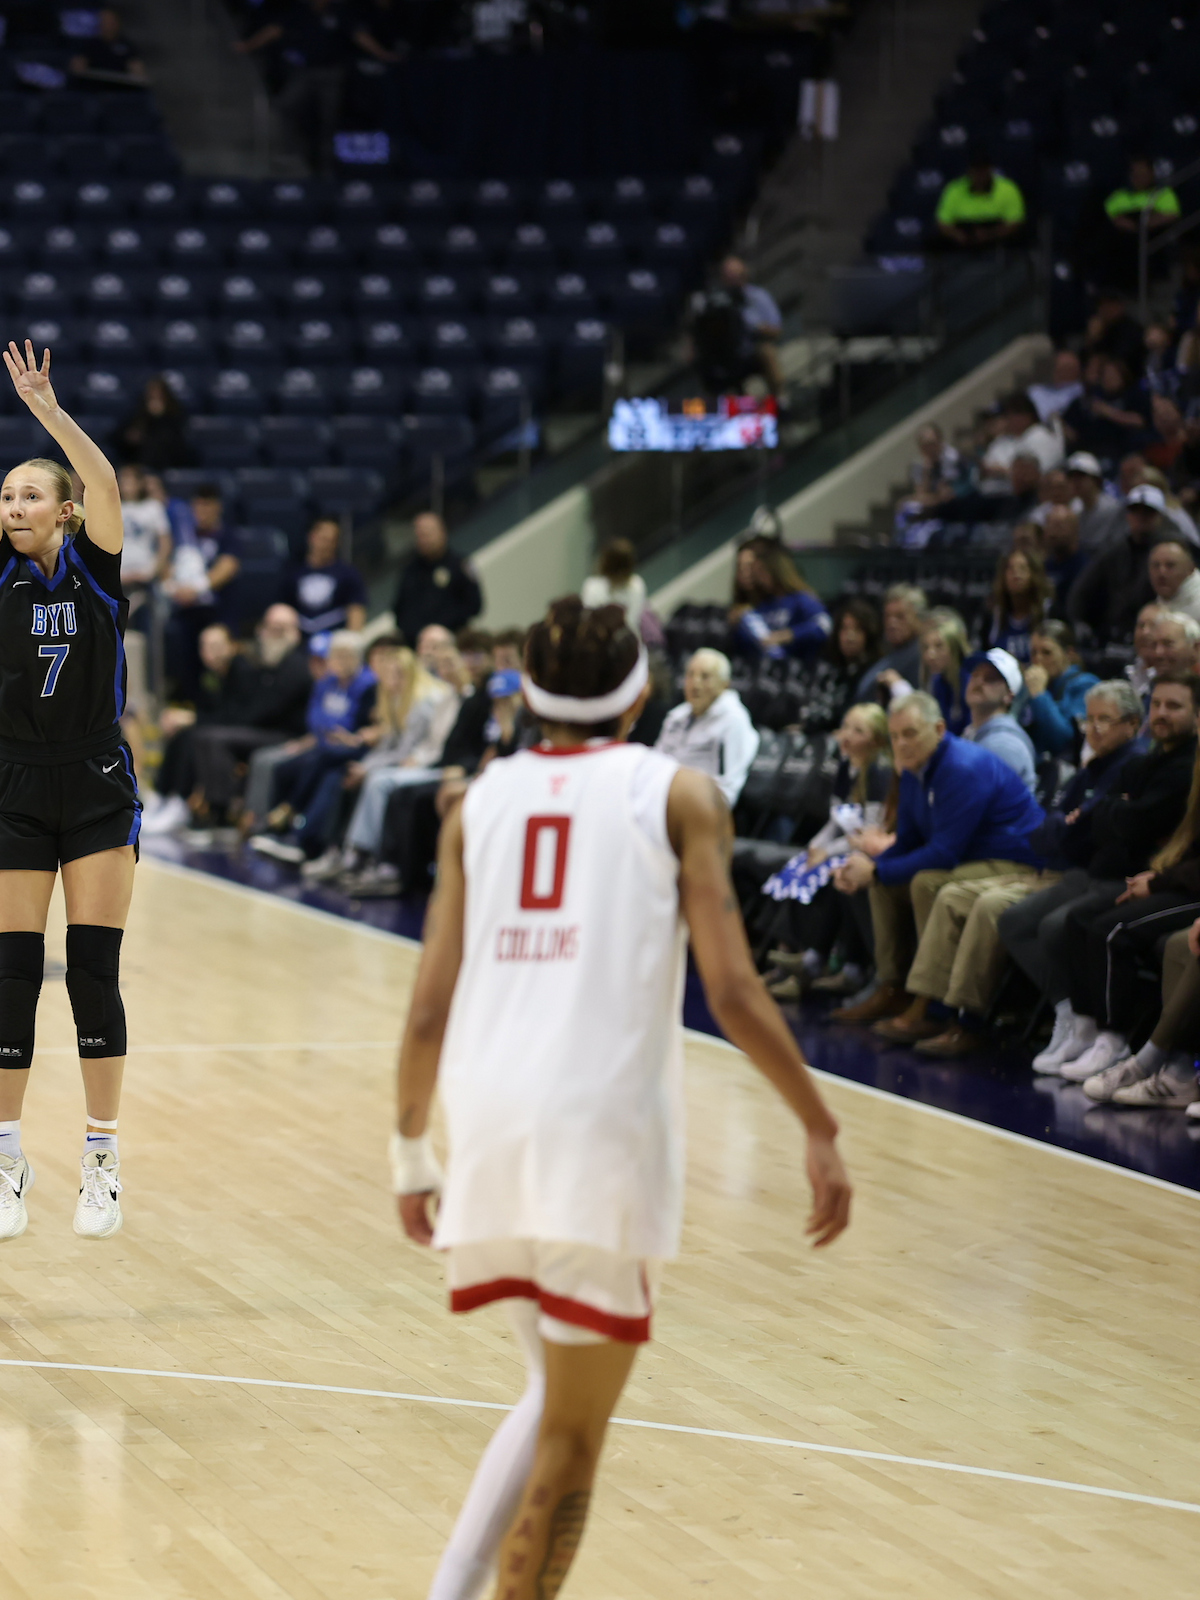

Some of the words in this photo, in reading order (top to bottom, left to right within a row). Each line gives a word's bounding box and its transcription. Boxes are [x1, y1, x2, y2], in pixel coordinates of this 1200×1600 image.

[31, 602, 77, 636] BYU
[38, 643, 70, 698] 7
[520, 815, 572, 910] 0
[496, 926, 580, 961] COLLINS
